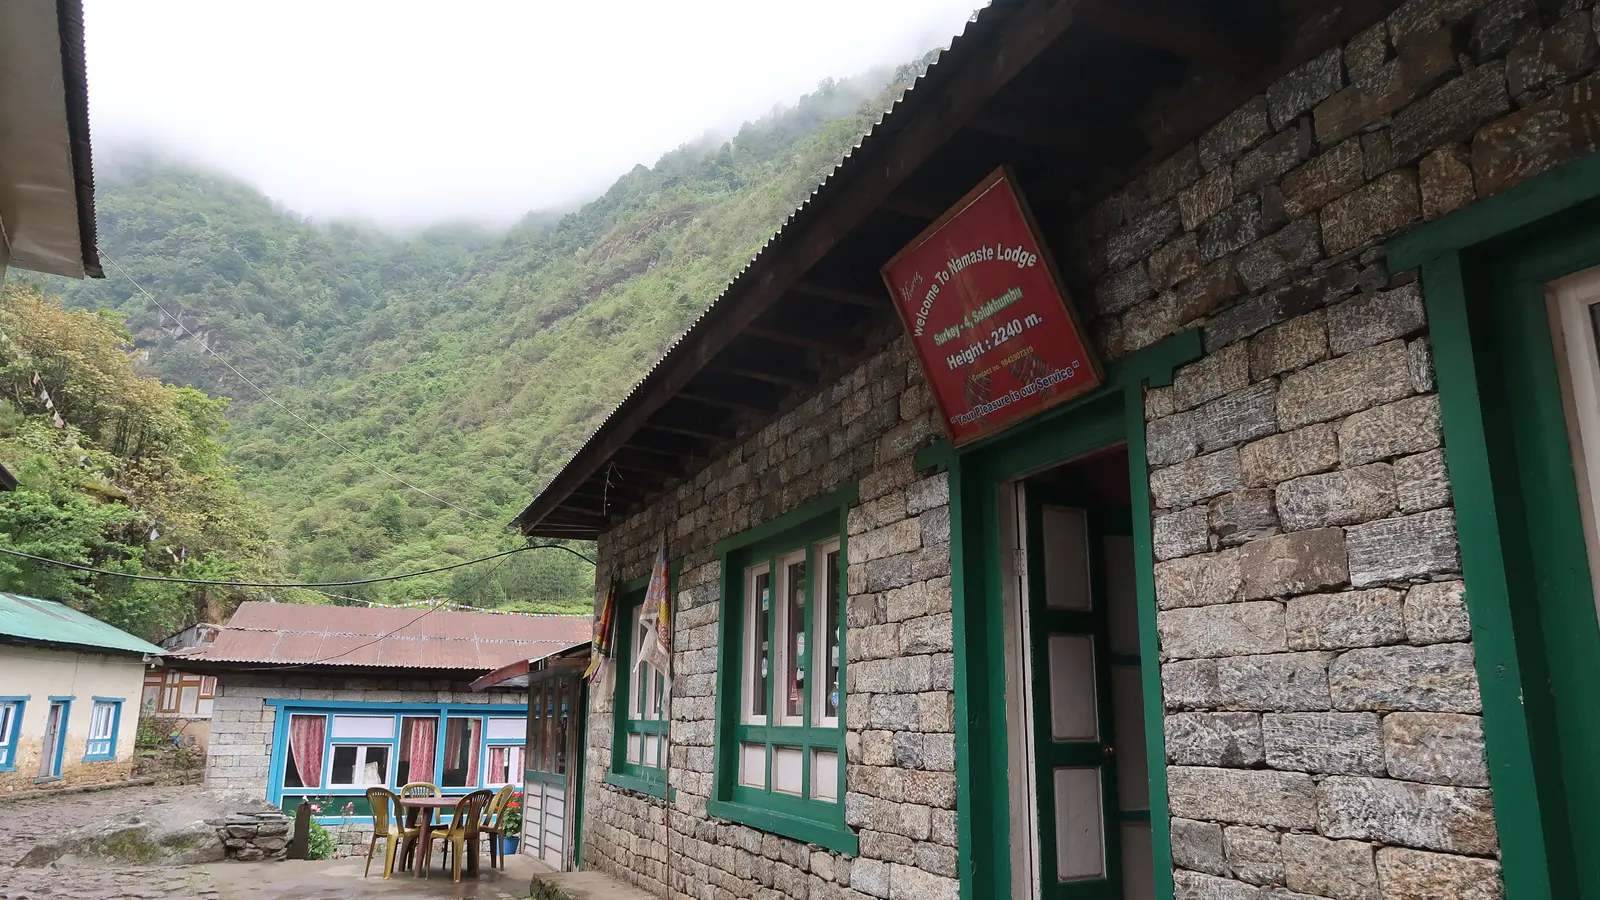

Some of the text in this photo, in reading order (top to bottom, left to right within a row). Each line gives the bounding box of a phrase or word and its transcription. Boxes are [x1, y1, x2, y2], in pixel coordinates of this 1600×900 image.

[914, 242, 1037, 337] welcome To Namaste Lodge
[971, 286, 1025, 324] Solukhumbu
[946, 340, 985, 370] Height
[991, 318, 1023, 347] 2240
[1024, 312, 1044, 329] m.
[972, 367, 992, 382] Contact
[974, 395, 1011, 417] Pleasure
[1010, 390, 1020, 402] is
[1021, 383, 1036, 398] our
